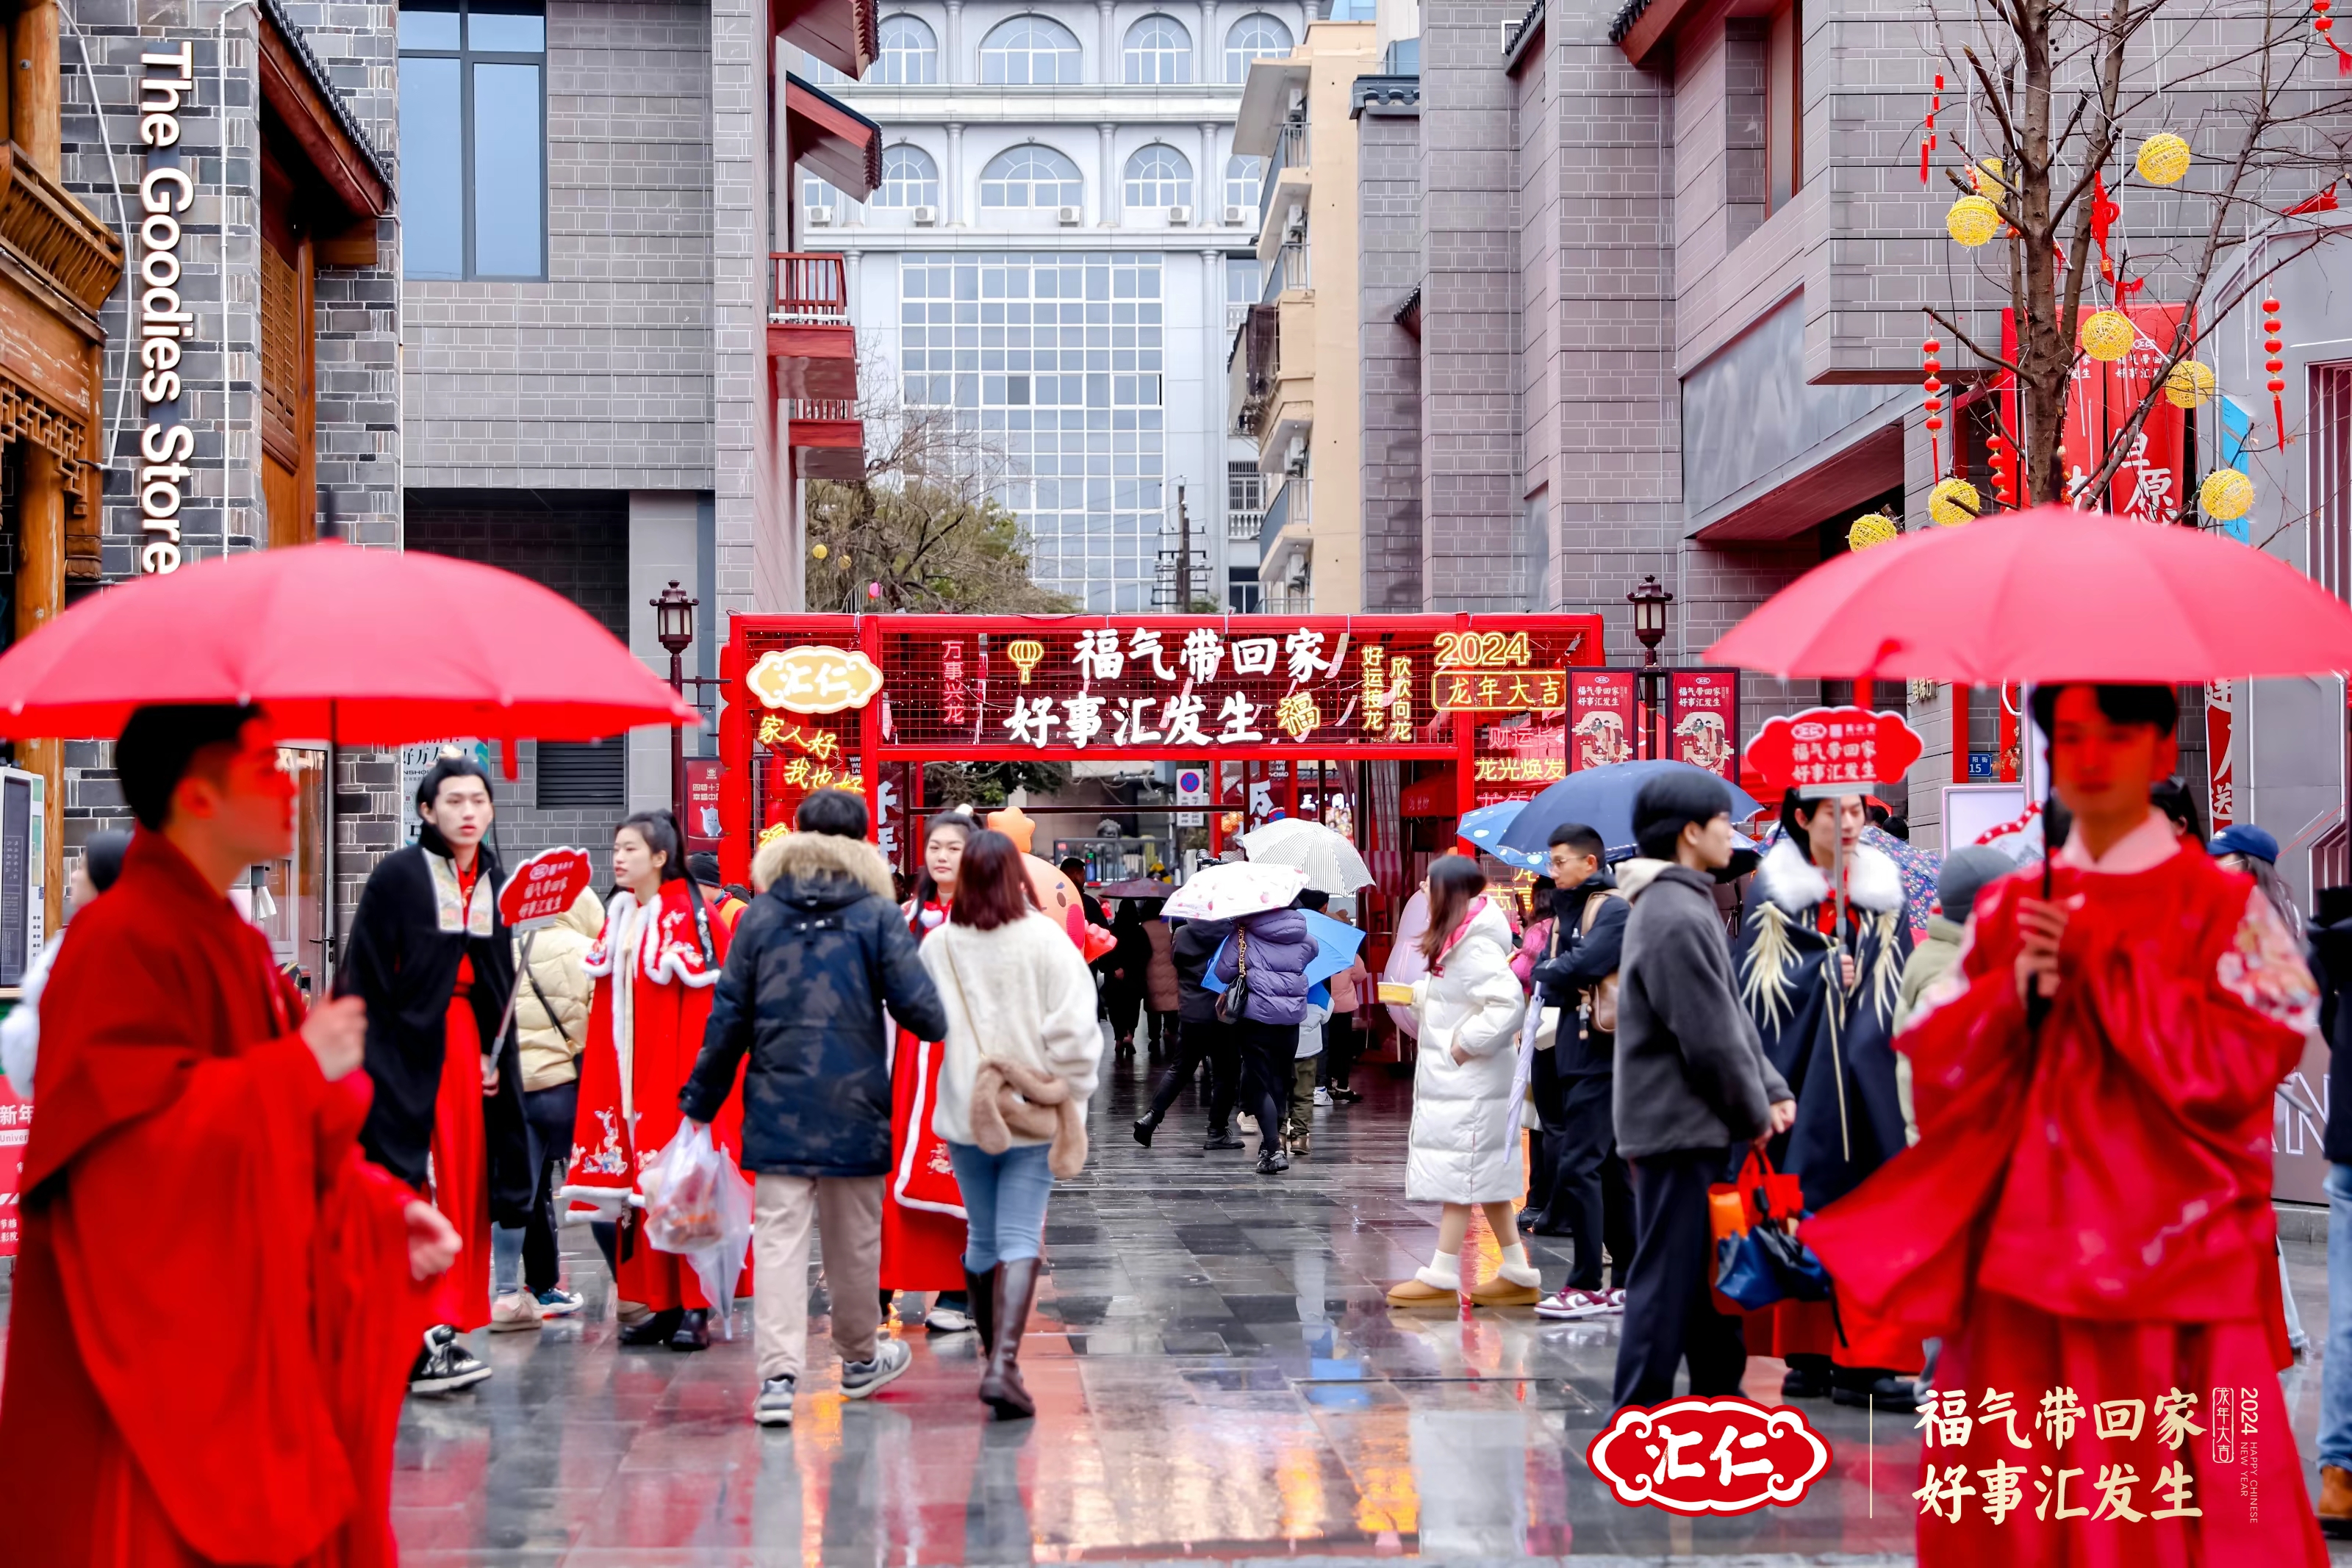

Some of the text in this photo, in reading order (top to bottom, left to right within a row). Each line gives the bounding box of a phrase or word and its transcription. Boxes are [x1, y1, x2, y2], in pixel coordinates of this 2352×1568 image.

[140, 41, 194, 574] The Goodies Store
[1072, 626, 1332, 684] 福气带回家
[1434, 630, 1531, 666] 2024
[780, 662, 852, 698] 汇仁
[942, 640, 965, 724] 万事兴龙
[1361, 644, 1385, 731] 好运接龙
[1446, 675, 1561, 707] 龙年大吉
[1577, 686, 1620, 696] 福气带回家
[1678, 686, 1721, 697] 福气带回家
[1274, 691, 1322, 738] 福
[1390, 655, 1413, 741] 欣欣向龙
[1577, 697, 1620, 707] 好事汇发生
[1678, 697, 1721, 708] 好事汇发生
[1003, 689, 1263, 749] 好事汇发生
[759, 715, 840, 760] 家人好
[1488, 727, 1566, 750] 财运长
[1792, 739, 1877, 762] 福气带回家
[1474, 757, 1566, 781] 龙光焕发
[1791, 760, 1877, 783] 好事汇发生
[0, 1231, 19, 1242] 影院
